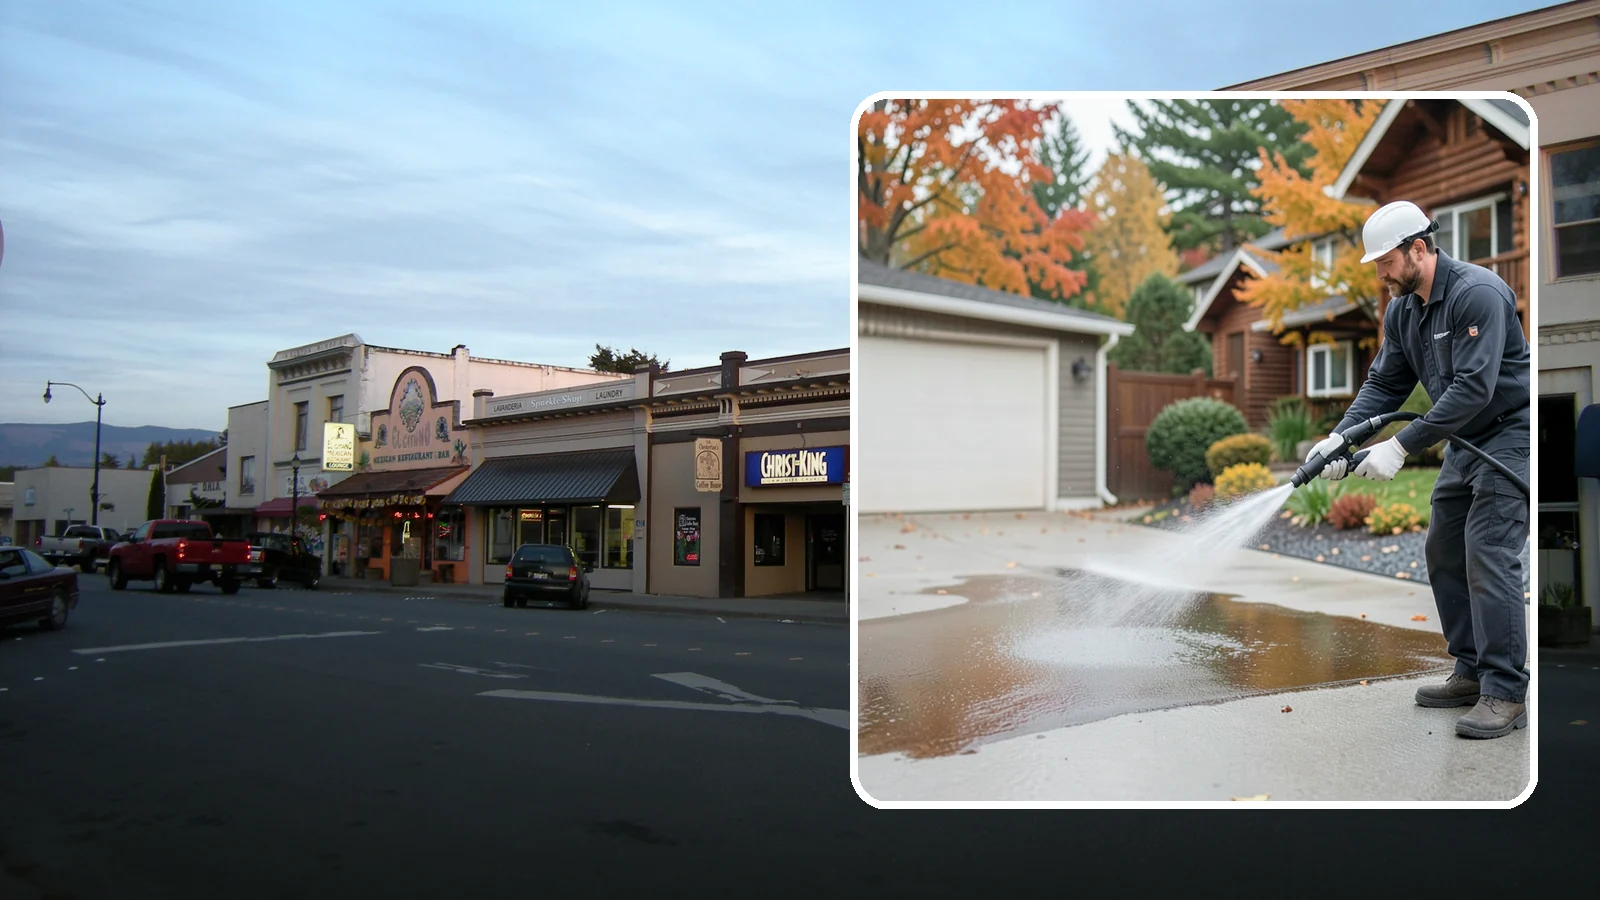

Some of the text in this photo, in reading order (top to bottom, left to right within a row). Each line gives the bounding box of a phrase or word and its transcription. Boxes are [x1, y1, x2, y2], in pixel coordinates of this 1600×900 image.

[595, 389, 623, 399] LAUNDRY
[493, 402, 522, 412] LAVANDERIA
[530, 394, 582, 408] Sparkle Shop
[398, 451, 433, 462] RESTAURANT
[438, 450, 450, 459] BAR
[761, 450, 827, 478] CHRIST KING
